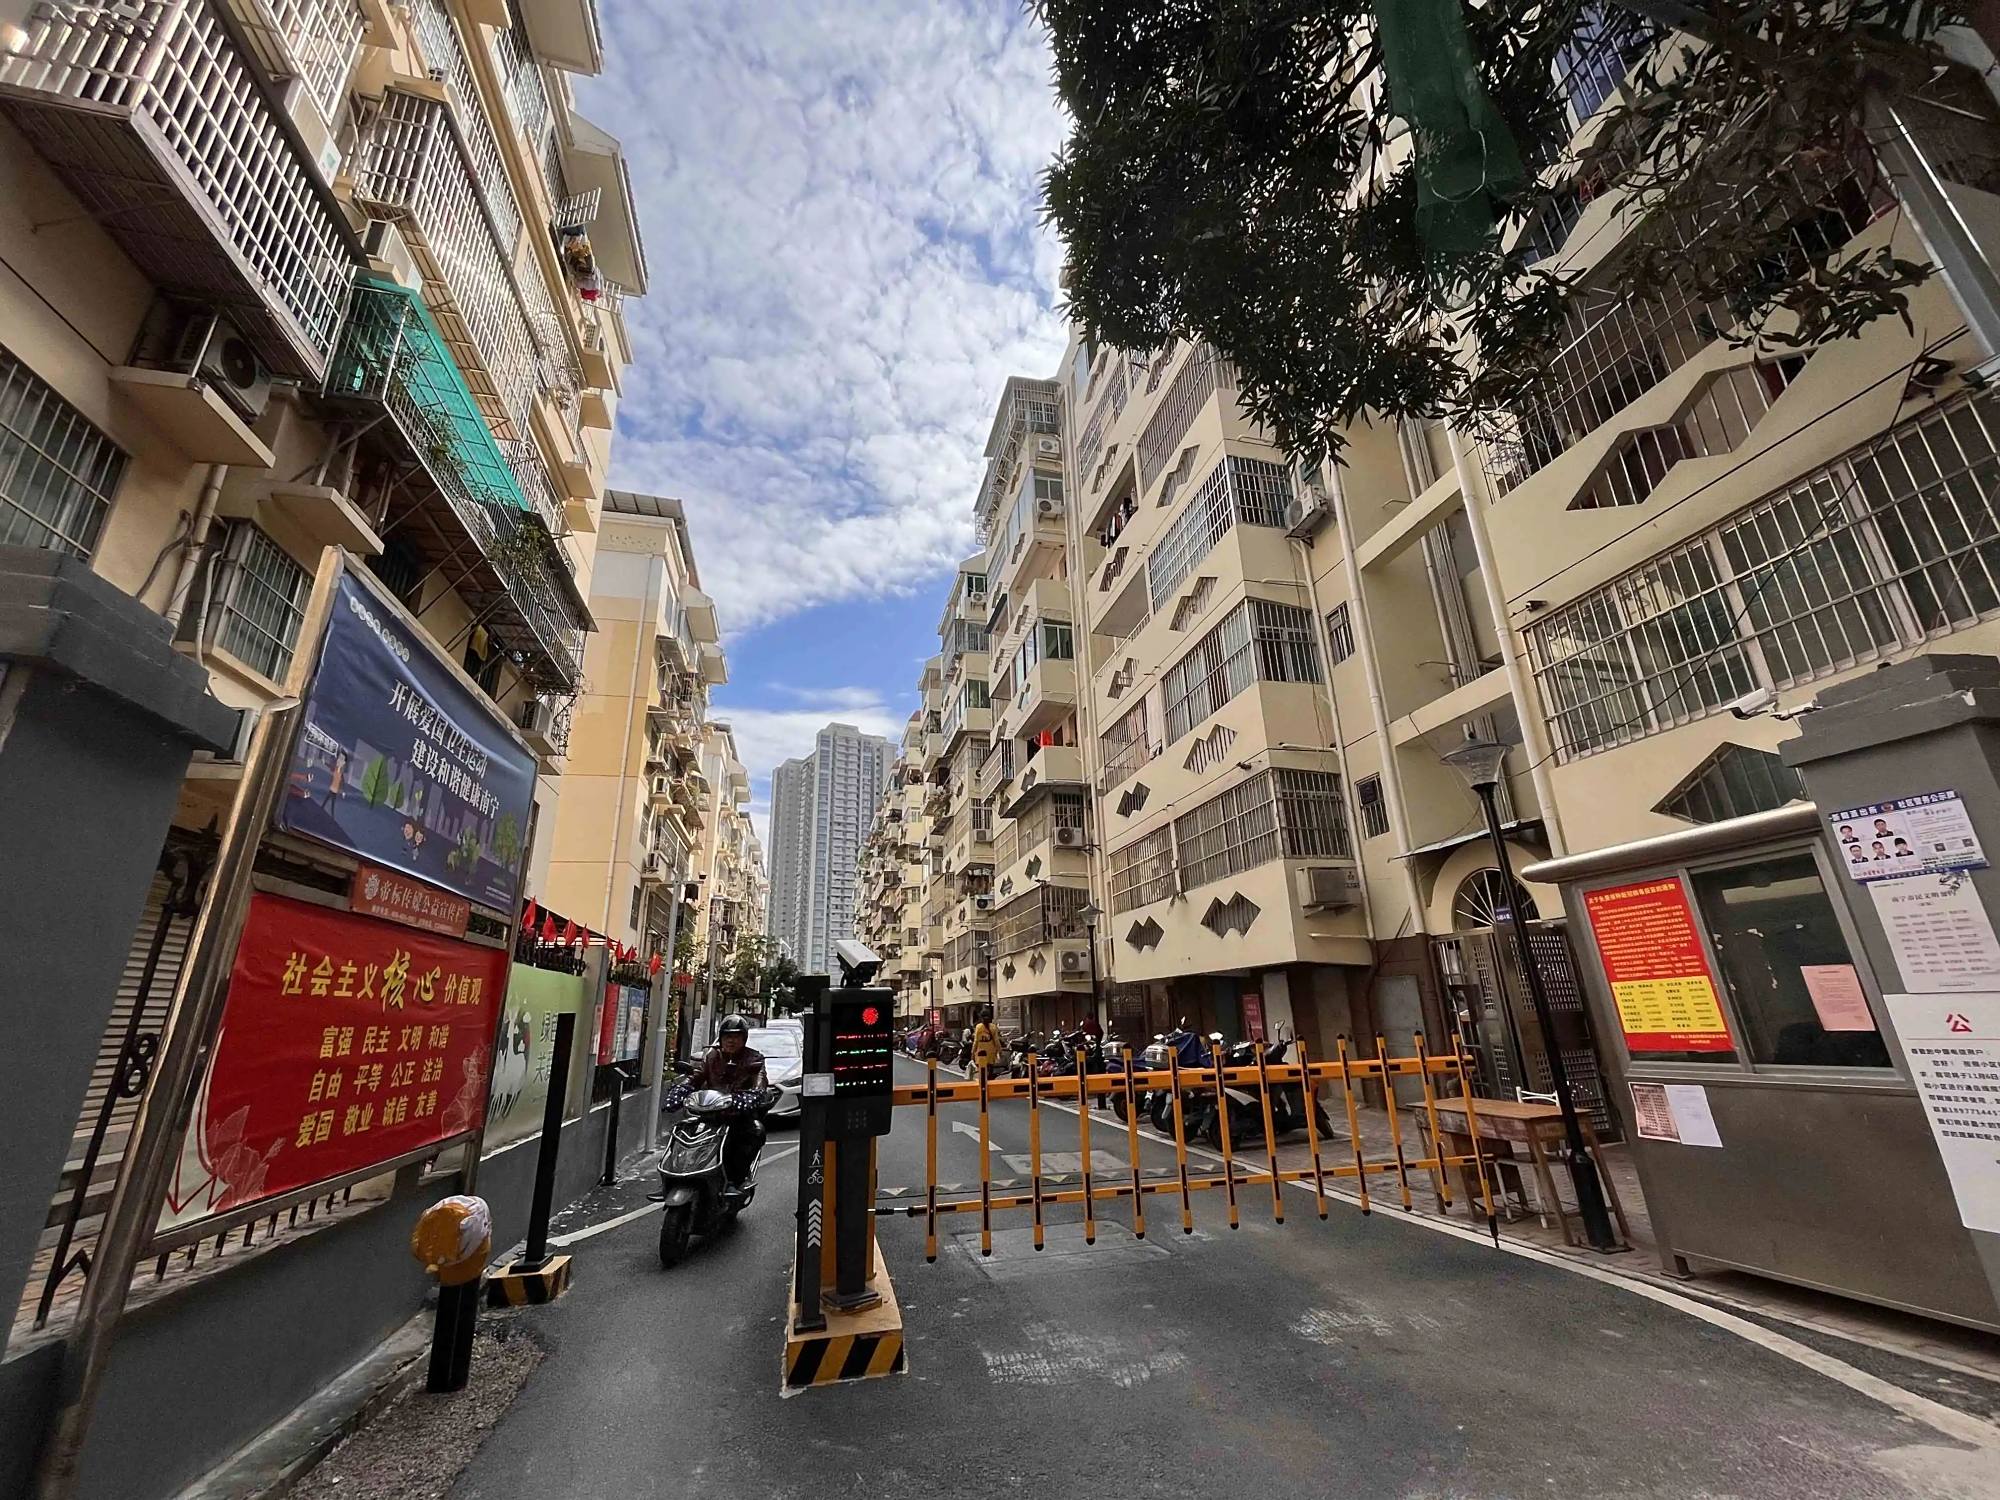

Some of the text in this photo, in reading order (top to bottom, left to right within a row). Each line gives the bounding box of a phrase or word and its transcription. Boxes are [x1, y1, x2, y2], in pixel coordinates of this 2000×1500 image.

[388, 679, 488, 779] 开展爱国卫生运动
[410, 738, 500, 819] 建设和谐健康南宁
[281, 948, 482, 1012] 社会主义核心价值观
[319, 1023, 450, 1059] 富强 民主 文明 和谐
[308, 1057, 444, 1104] 自由 平等 公正 法治
[295, 1090, 438, 1149] 爱国 敬业 诚信 友善
